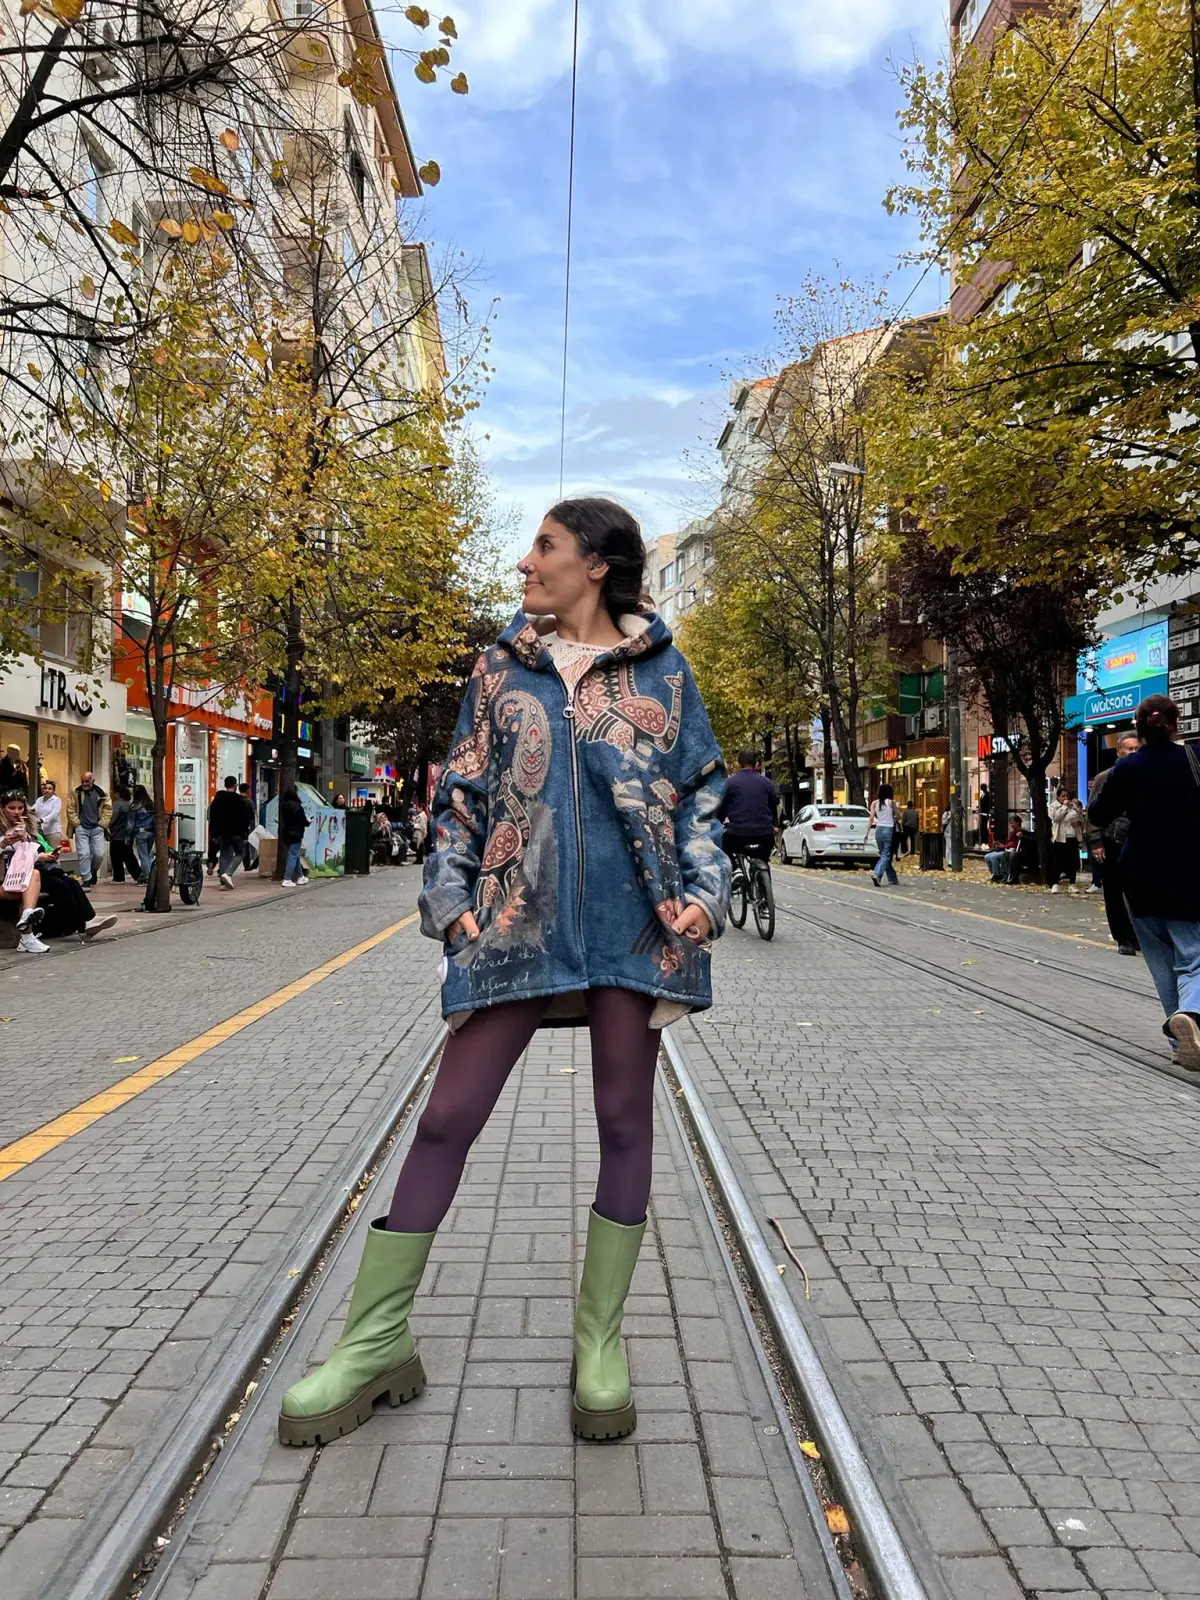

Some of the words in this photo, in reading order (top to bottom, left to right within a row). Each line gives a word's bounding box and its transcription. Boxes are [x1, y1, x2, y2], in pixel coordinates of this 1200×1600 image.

[41, 666, 66, 711] LTB
[1091, 694, 1133, 713] watsons
[47, 734, 66, 749] LTB
[979, 736, 991, 758] IN
